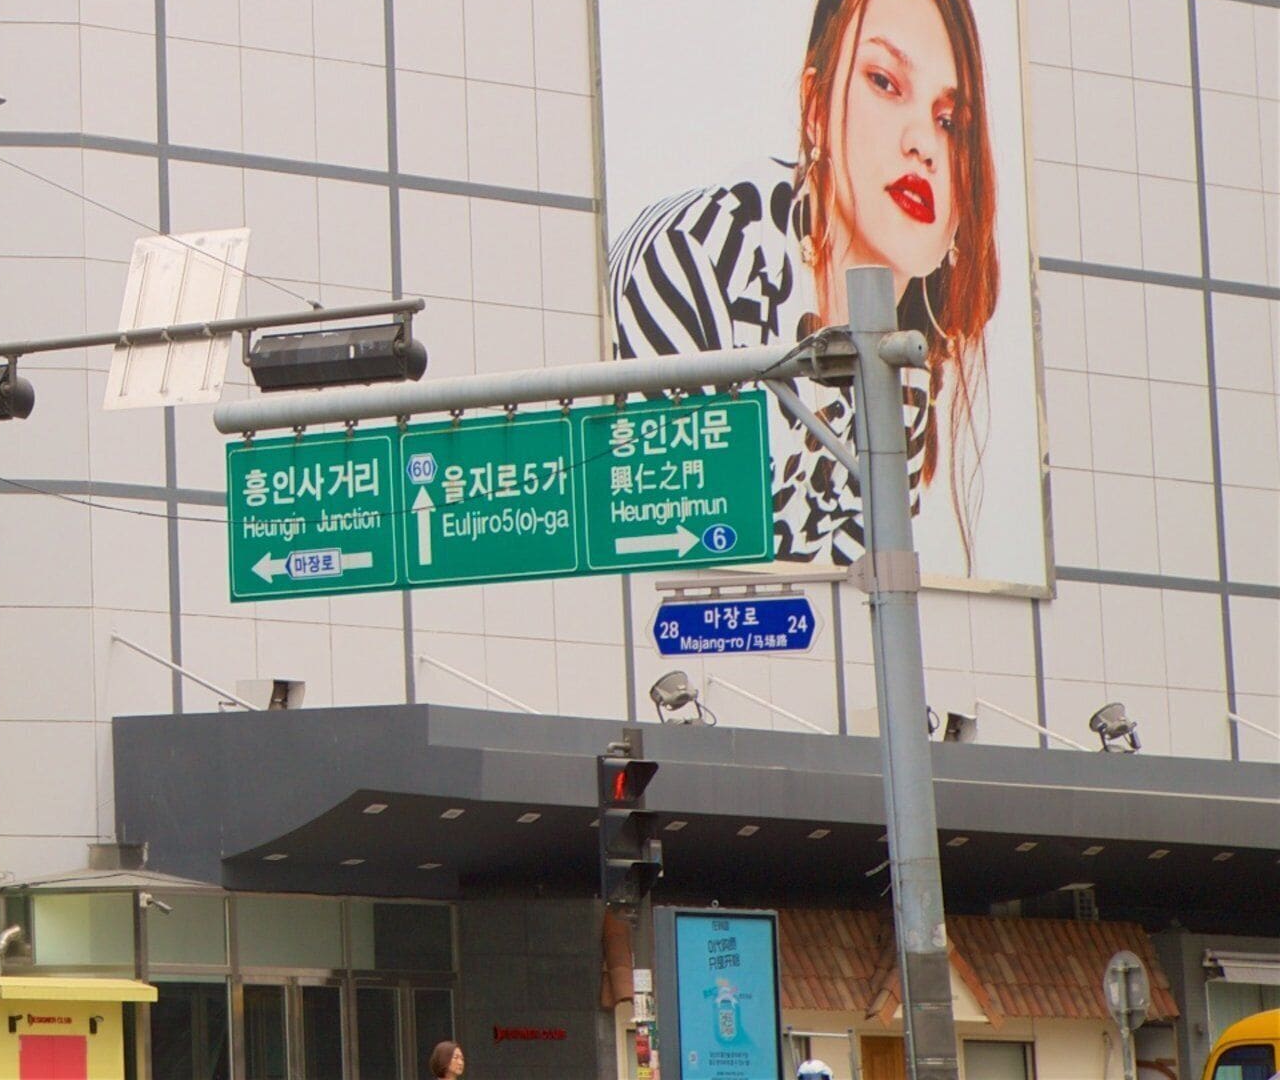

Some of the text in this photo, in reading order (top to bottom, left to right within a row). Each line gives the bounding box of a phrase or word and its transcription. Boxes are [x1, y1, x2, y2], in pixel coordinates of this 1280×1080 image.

[609, 409, 732, 458] 흥인지문
[413, 460, 433, 477] 60
[441, 456, 568, 504] 을지로5가
[610, 459, 705, 496] 興仁之門
[243, 458, 380, 508] 흥인사거리
[243, 506, 382, 542] Heungin Junction
[611, 496, 728, 526] Heunginjimun
[712, 527, 727, 551] 6
[294, 555, 336, 575] 마장로
[660, 621, 679, 639] 28
[704, 606, 760, 629] 마장로
[787, 615, 808, 634] 24
